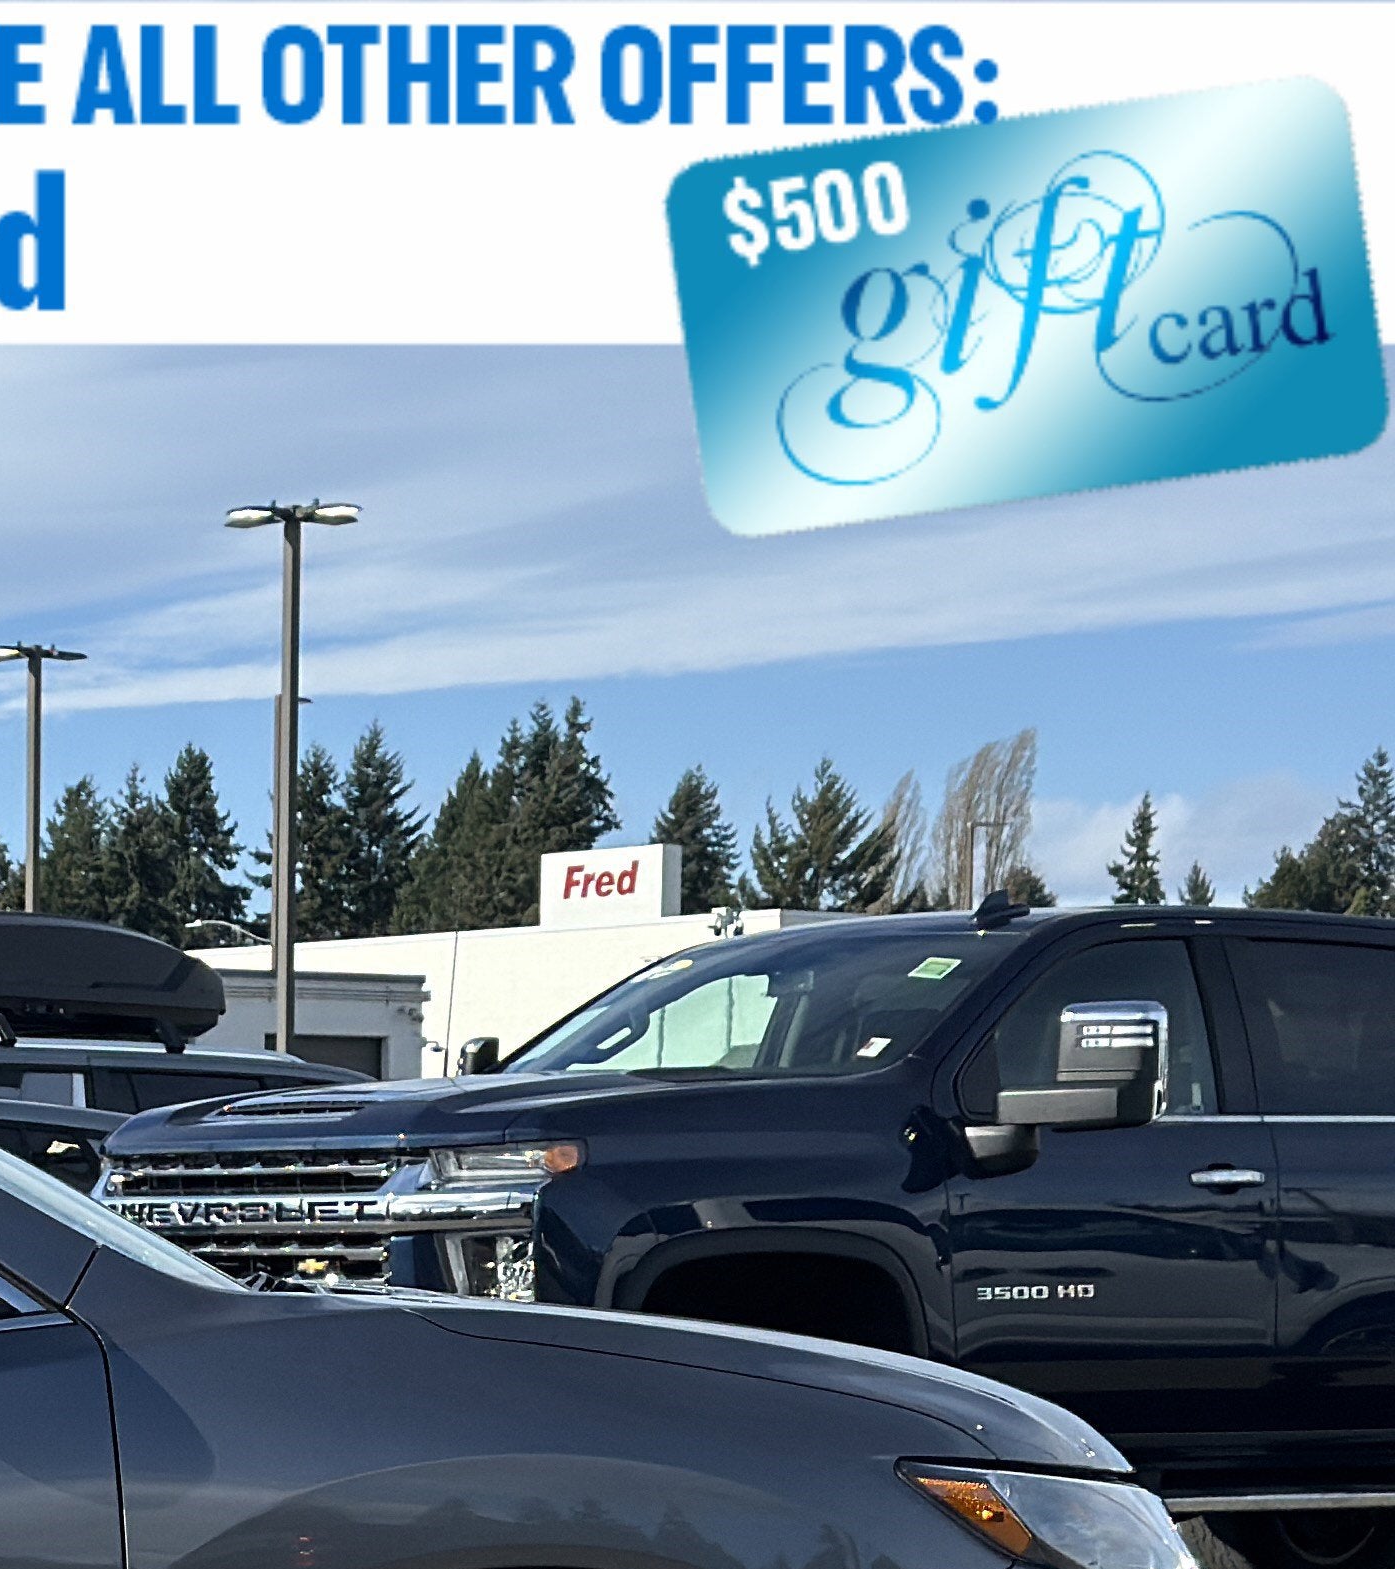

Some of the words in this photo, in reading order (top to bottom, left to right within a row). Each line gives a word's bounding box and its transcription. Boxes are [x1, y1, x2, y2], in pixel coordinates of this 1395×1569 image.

[563, 860, 639, 899] Fred
[977, 1286, 1049, 1300] 3500
[1057, 1284, 1095, 1298] HD
